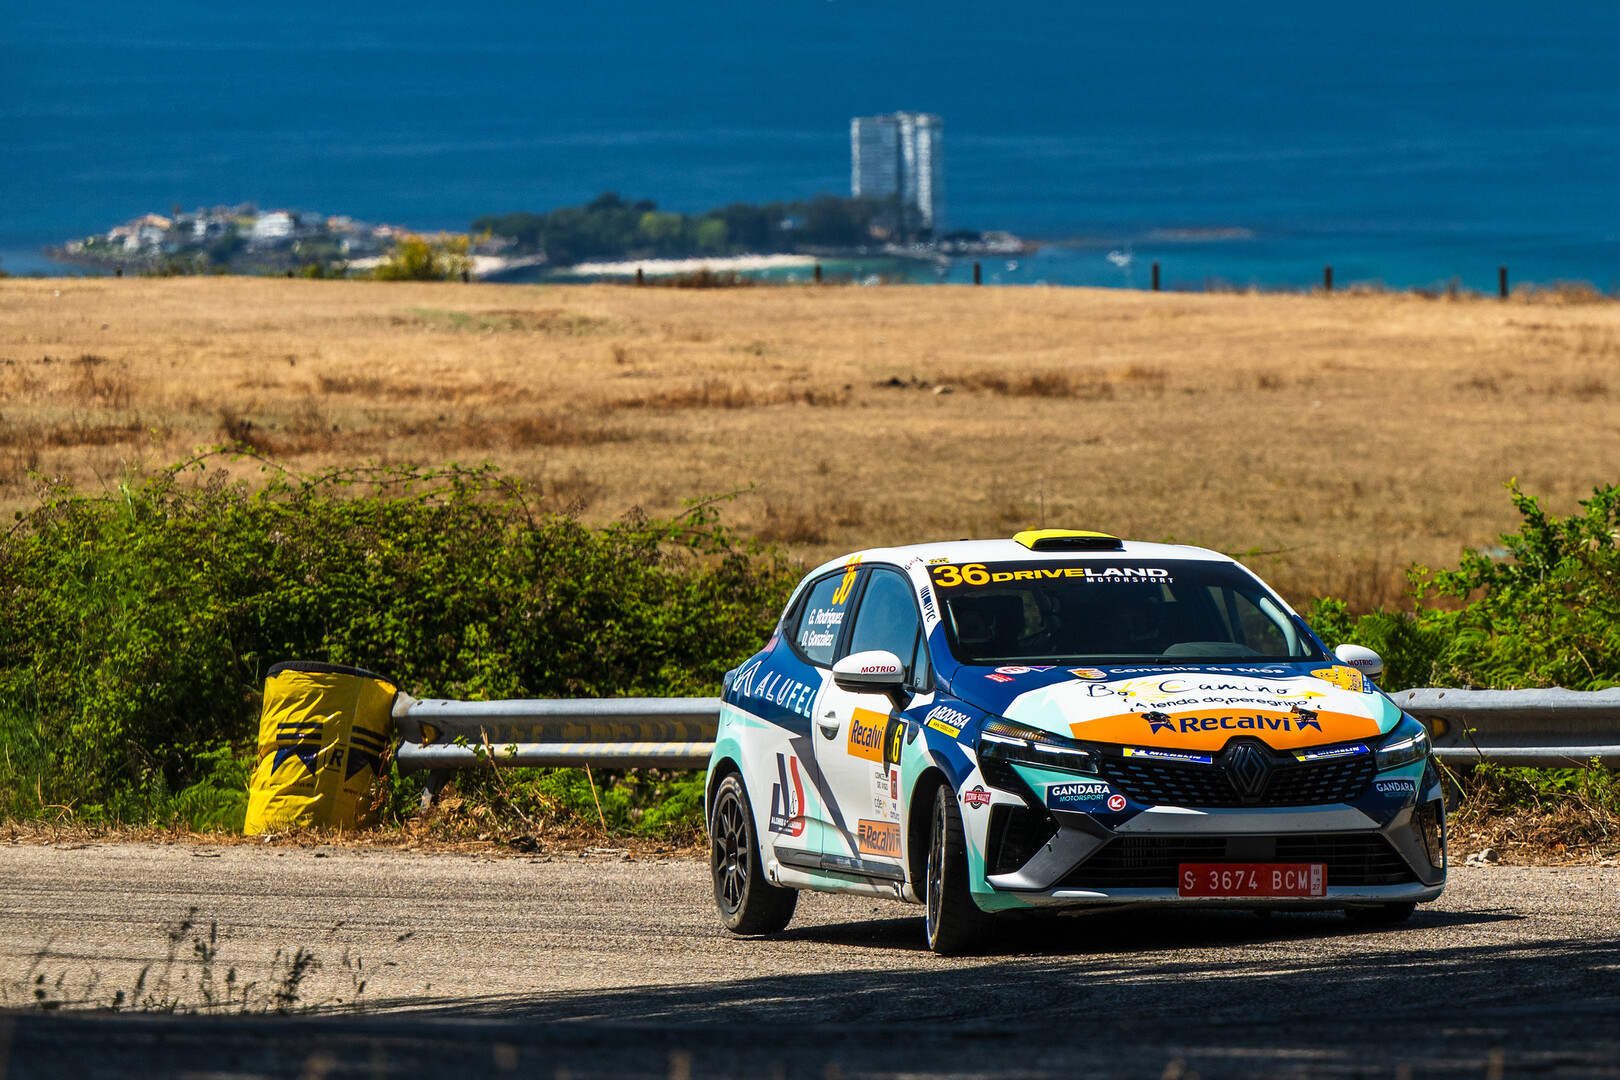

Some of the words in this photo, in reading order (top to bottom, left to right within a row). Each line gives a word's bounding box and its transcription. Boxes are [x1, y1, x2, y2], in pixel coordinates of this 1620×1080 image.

[932, 563, 991, 587] 36
[992, 568, 1169, 582] DRIVELAND
[923, 602, 937, 623] PTC
[860, 665, 897, 674] MOTRIO
[754, 670, 817, 719] ALUFEL
[1150, 698, 1199, 709] tenda
[1228, 696, 1308, 707] peregrino
[1178, 715, 1292, 733] Recalvi
[850, 719, 885, 750] Recalvi
[1149, 750, 1202, 760] MICHELIN
[1052, 784, 1111, 796] GANDARA
[1376, 782, 1415, 792] GANDARA
[1059, 794, 1105, 802] MOTORSPORT
[866, 825, 896, 852] Recalvi
[1184, 871, 1195, 889] S
[1209, 871, 1258, 889] 3674
[1272, 870, 1308, 889] BCM
